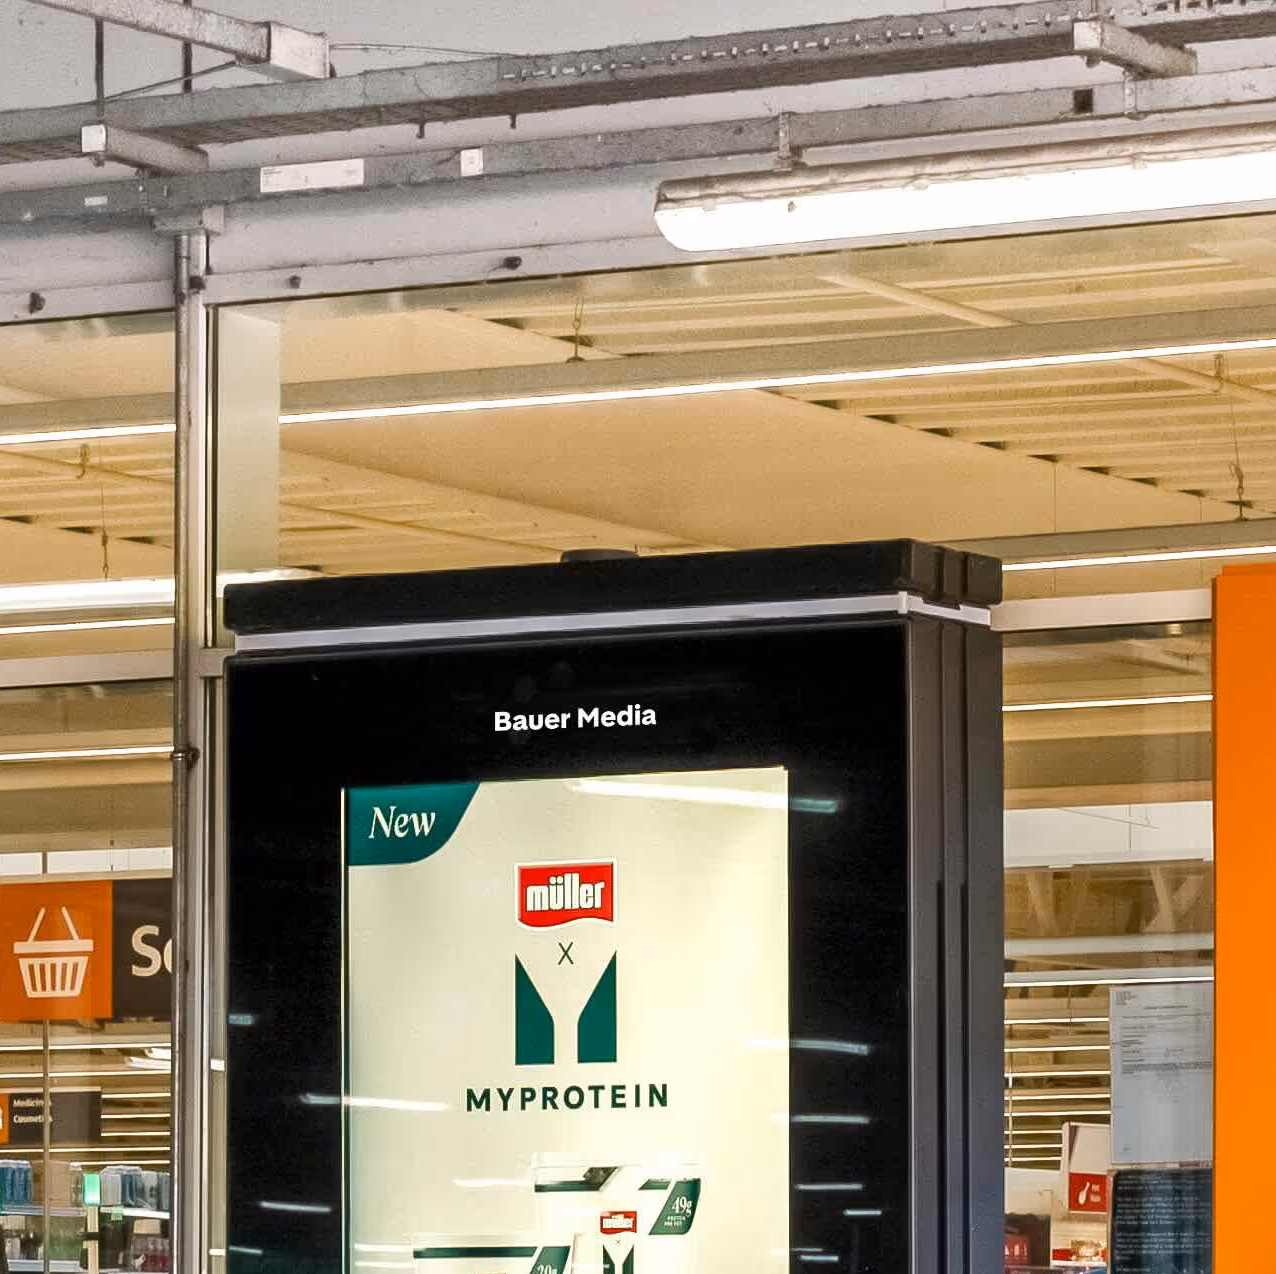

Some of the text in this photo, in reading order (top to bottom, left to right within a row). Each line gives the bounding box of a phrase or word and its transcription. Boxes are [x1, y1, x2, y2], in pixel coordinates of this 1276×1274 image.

[493, 704, 657, 732] Bauer Media
[368, 805, 436, 840] New
[525, 872, 605, 913] müller
[466, 1082, 669, 1113] MYPROTEIN
